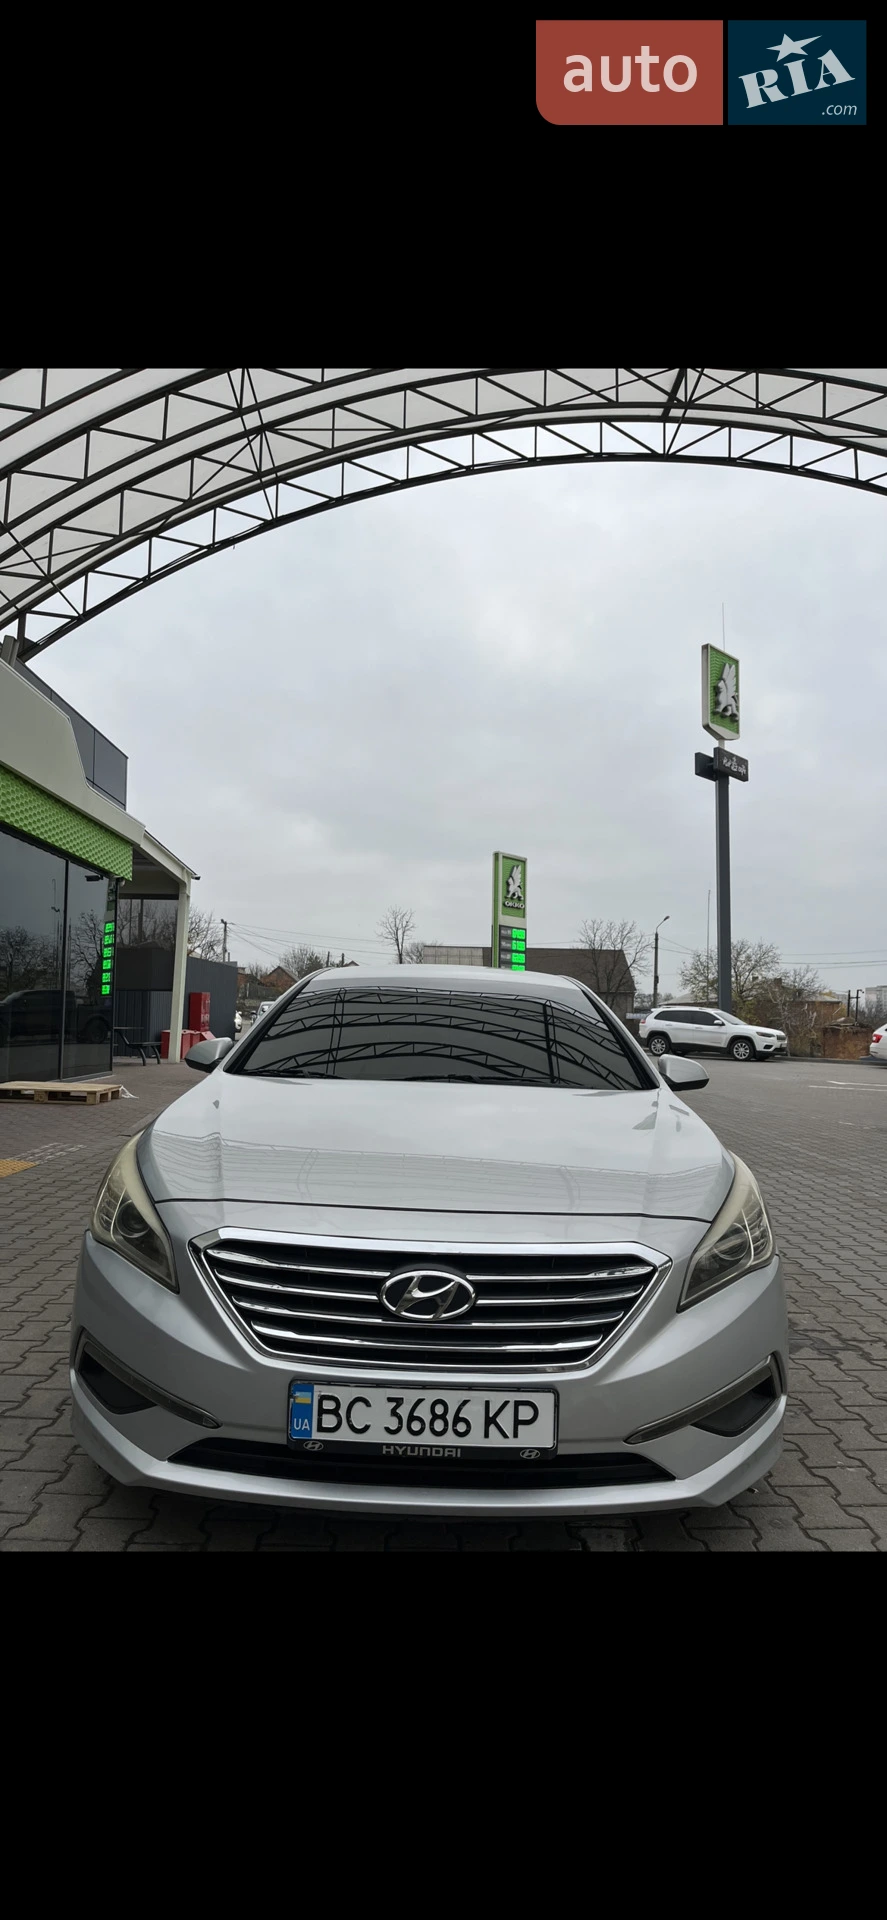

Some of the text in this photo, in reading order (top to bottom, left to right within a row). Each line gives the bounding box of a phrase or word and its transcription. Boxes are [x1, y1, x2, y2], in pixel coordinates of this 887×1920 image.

[504, 900, 525, 909] OKKO
[293, 1394, 540, 1440] UA BC 3686 KP
[382, 1444, 462, 1458] HYUNDAI
